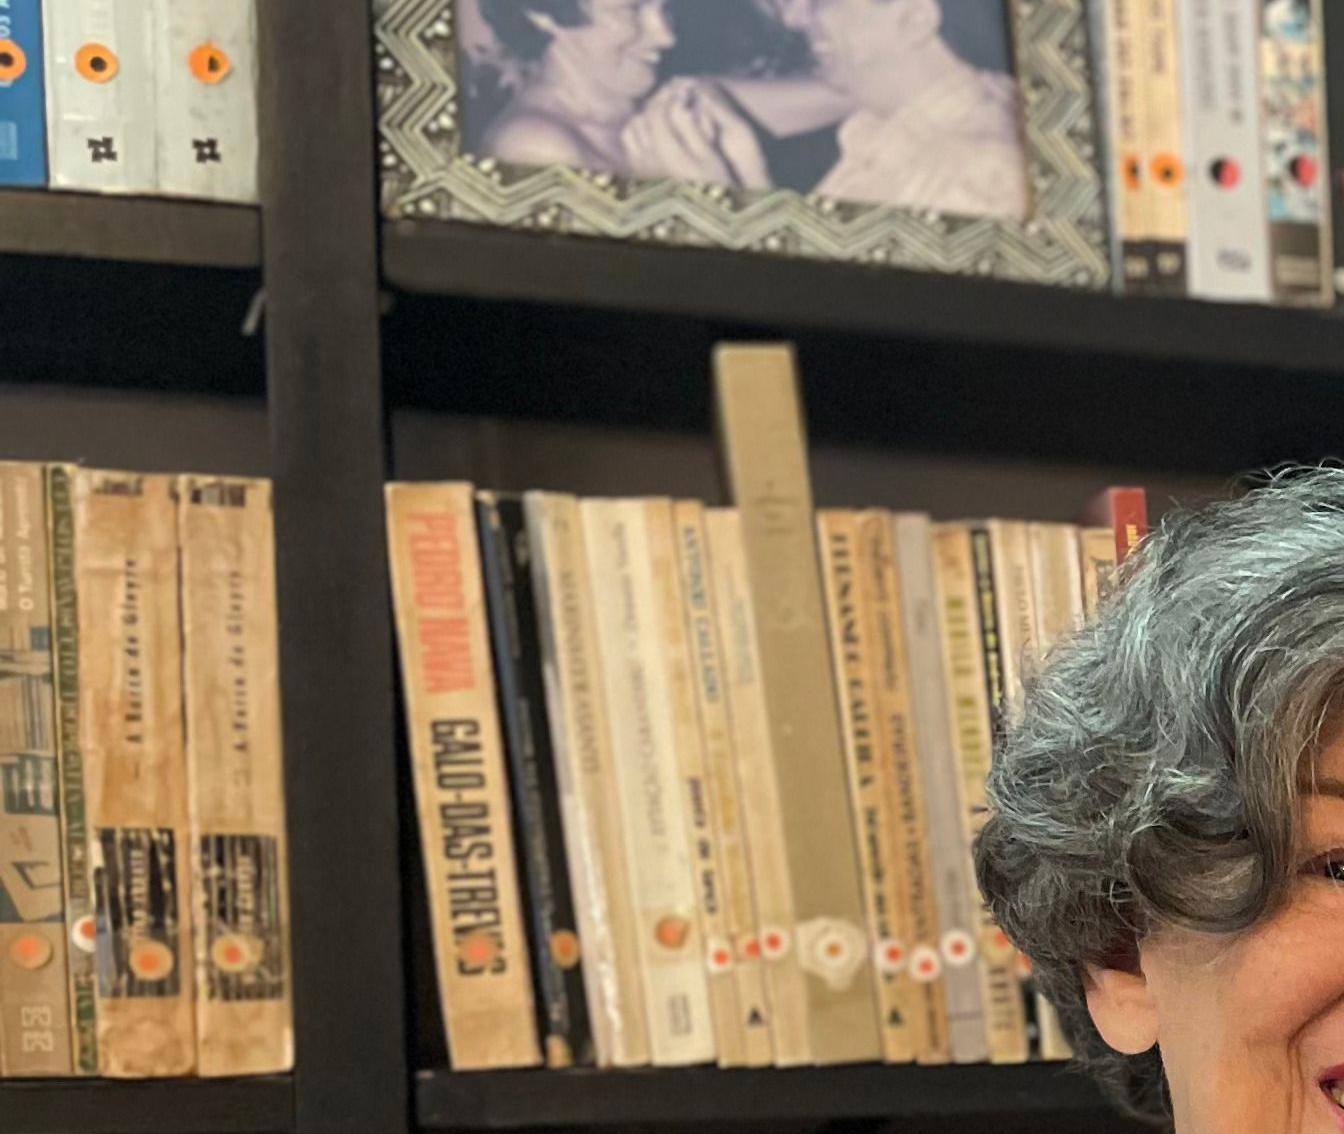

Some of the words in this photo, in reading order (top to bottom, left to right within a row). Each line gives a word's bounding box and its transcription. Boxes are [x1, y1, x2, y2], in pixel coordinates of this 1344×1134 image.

[120, 558, 141, 627] Gleyre
[406, 512, 466, 609] PEDRO
[123, 635, 140, 658] de
[227, 645, 244, 667] de
[418, 617, 476, 694] NAVA
[124, 665, 142, 724] Barca
[430, 718, 507, 976] GALO-DAS-TREVS
